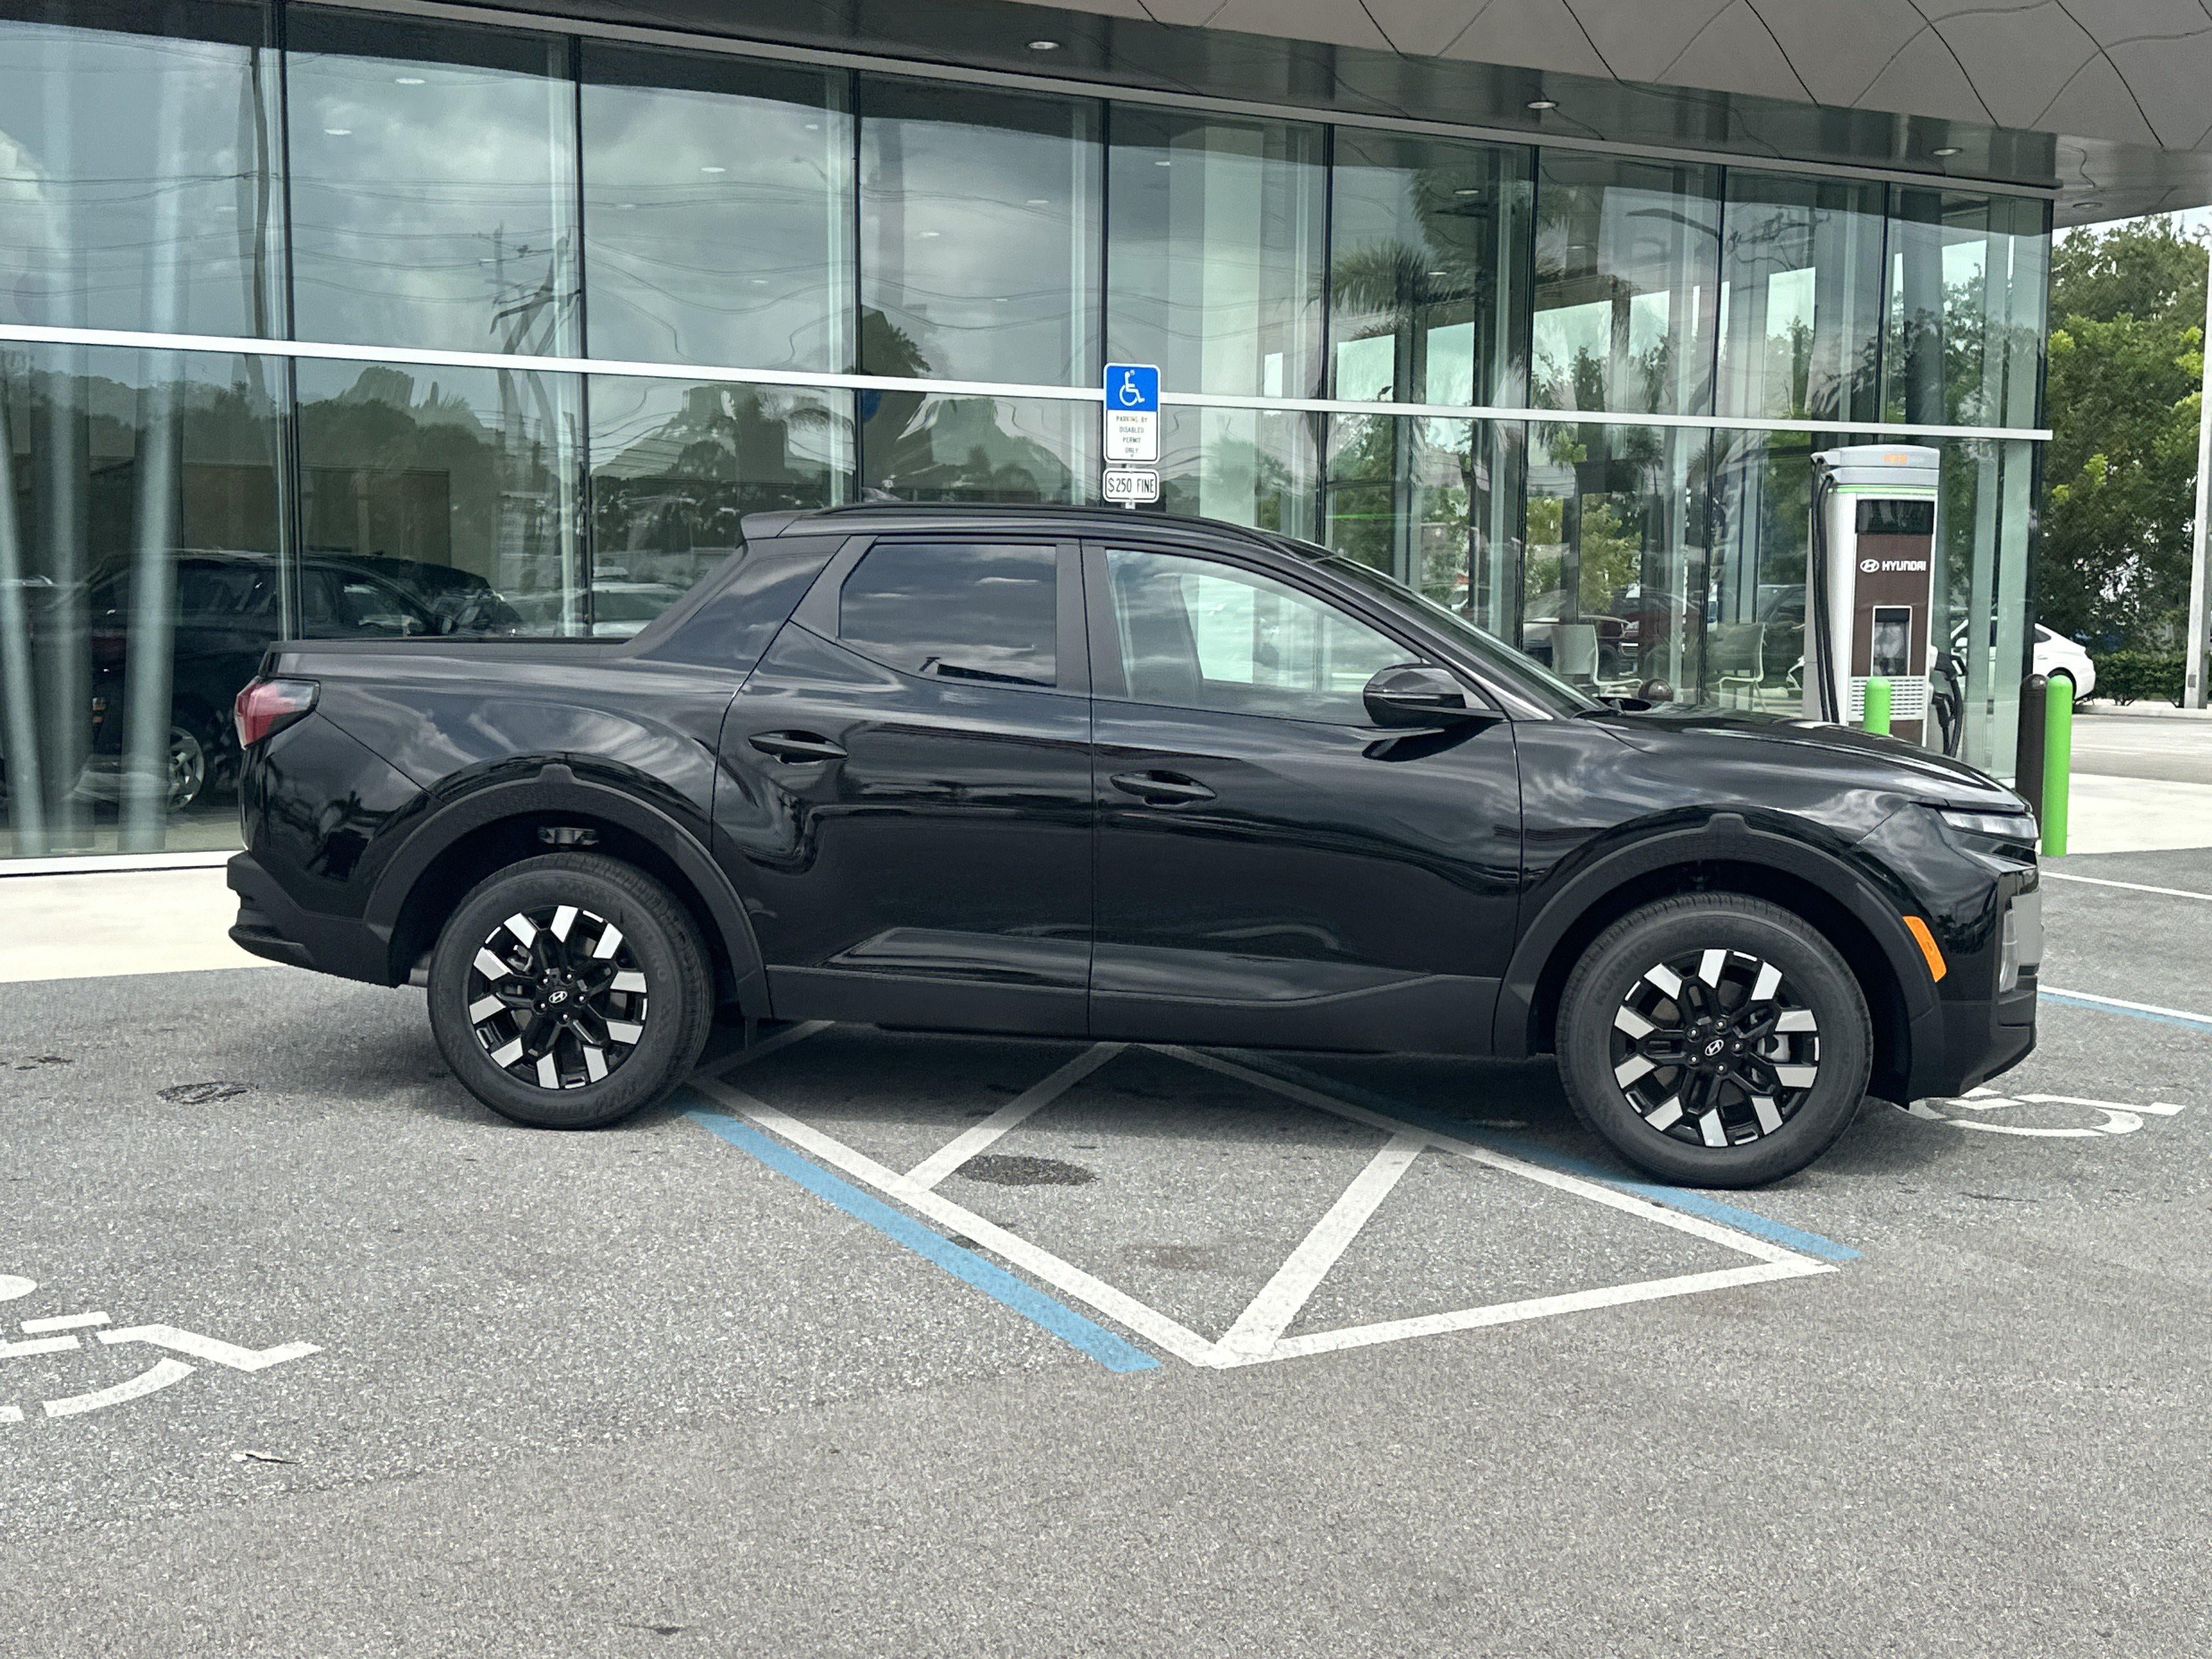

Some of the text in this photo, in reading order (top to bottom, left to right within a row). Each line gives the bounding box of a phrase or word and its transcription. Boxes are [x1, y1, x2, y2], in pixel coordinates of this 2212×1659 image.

[1108, 477, 1155, 493] $250 FINE
[1882, 560, 1927, 571] HYUNDAI
